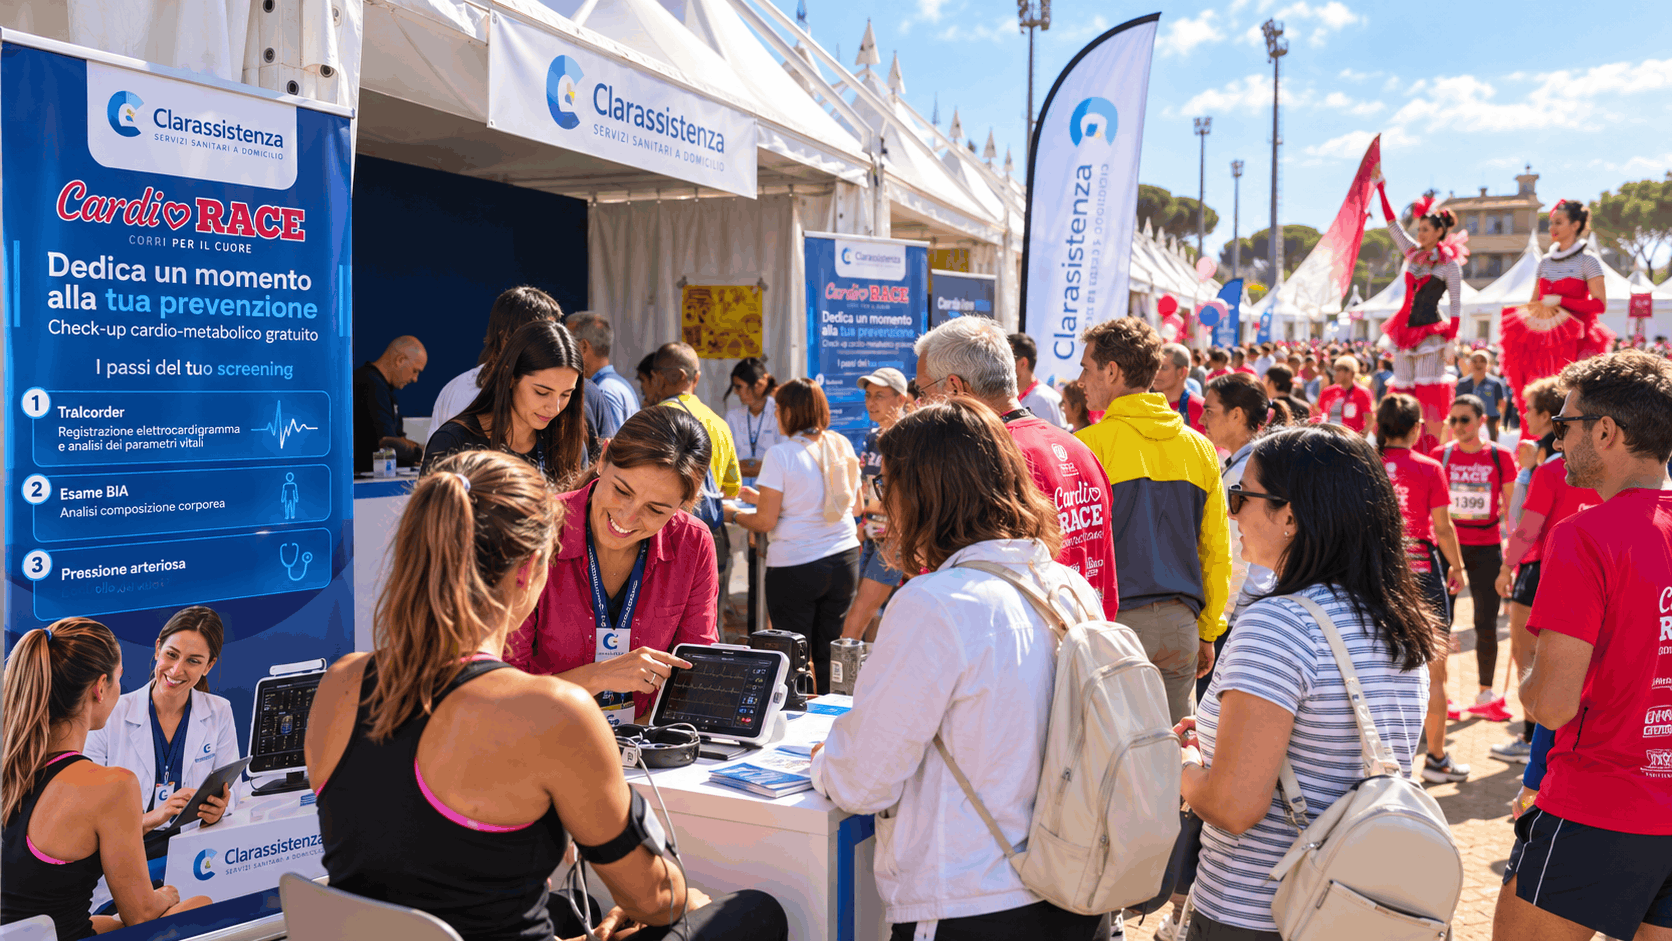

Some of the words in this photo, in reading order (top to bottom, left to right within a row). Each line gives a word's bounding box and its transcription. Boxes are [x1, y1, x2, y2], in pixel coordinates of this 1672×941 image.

[153, 108, 284, 149] Clarassistenza
[593, 82, 725, 154] Clarassistenza
[154, 133, 188, 146] SERVIZI
[191, 139, 230, 152] SANITARI
[233, 146, 239, 154] A
[242, 147, 284, 160] DOMICILIO
[593, 123, 629, 144] SERVIZI
[632, 135, 672, 157] SANITARI
[675, 149, 681, 160] A
[684, 151, 725, 172] DOMICILIO
[195, 197, 306, 243] RACE
[128, 234, 167, 247] CORRI
[172, 238, 195, 249] PER
[200, 240, 210, 250] IL
[215, 241, 252, 253] CUORE
[47, 251, 146, 282] Dedica
[154, 264, 187, 284] un
[195, 267, 312, 291] momento
[1053, 164, 1092, 360] Clarasistenza
[47, 284, 97, 310] alla
[105, 288, 152, 313] tua
[160, 294, 318, 319] prevenzione
[822, 310, 854, 324] Dedica
[855, 314, 868, 324] un
[869, 314, 913, 326] momento
[48, 319, 127, 340] Check-up
[130, 323, 262, 341] cardio-metabolico
[265, 326, 319, 344] gratuito
[821, 324, 838, 337] alla
[96, 358, 100, 375] I
[106, 359, 151, 379] passi
[155, 359, 181, 376] del
[185, 361, 213, 376] tuo
[217, 362, 294, 380] screening
[31, 395, 40, 411] 1
[58, 425, 134, 441] Registrazione
[136, 423, 241, 437] elettrocardigramma
[58, 443, 66, 452] e
[68, 439, 103, 452] analisi
[105, 438, 122, 451] dei
[125, 438, 177, 453] parametri
[179, 436, 204, 448] vitali
[31, 482, 43, 497] 2
[60, 487, 103, 501] Esame
[106, 484, 129, 498] BIA
[60, 505, 98, 518] Analisi
[100, 503, 176, 517] composizione
[178, 500, 226, 512] corporea
[1455, 496, 1485, 510] 1399
[1057, 504, 1104, 535] RACE
[31, 557, 43, 573] 3
[61, 564, 127, 581] Pressione
[130, 559, 187, 574] arteriosa
[224, 834, 323, 865] Clarassistenza
